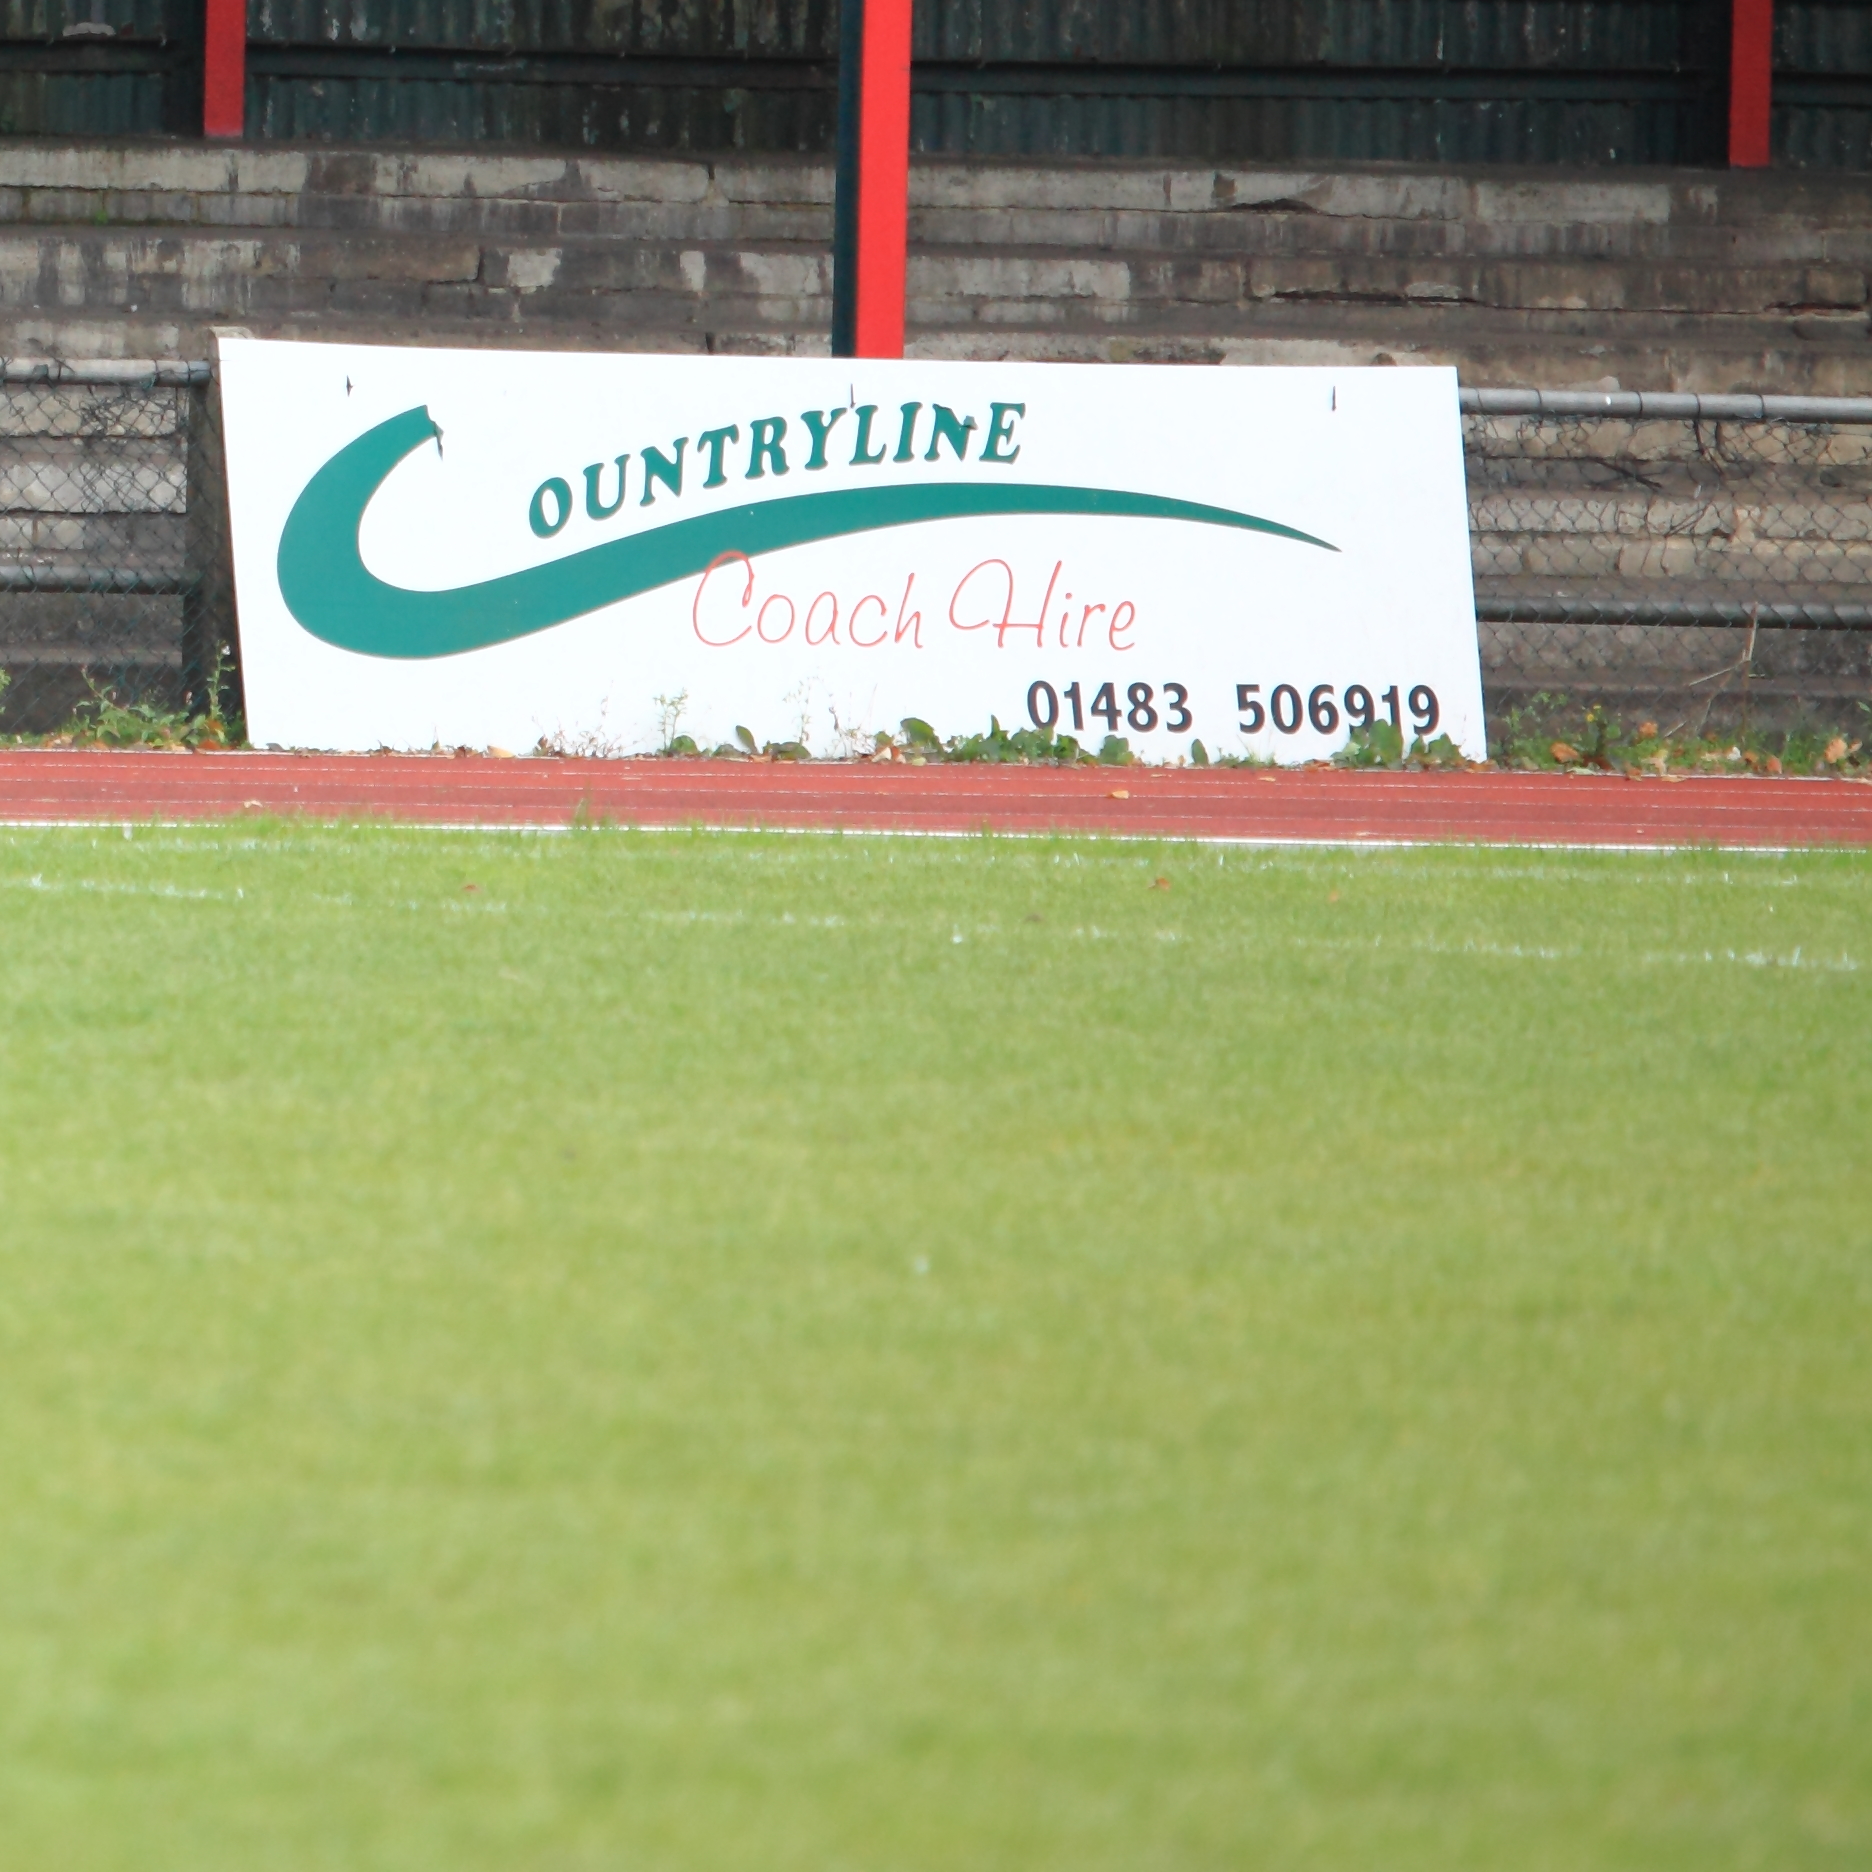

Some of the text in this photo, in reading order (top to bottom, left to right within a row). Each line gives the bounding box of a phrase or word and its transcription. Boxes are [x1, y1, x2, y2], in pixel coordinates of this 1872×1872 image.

[691, 548, 1137, 652] Coach Hire
[1025, 678, 1441, 736] 01483 506919
